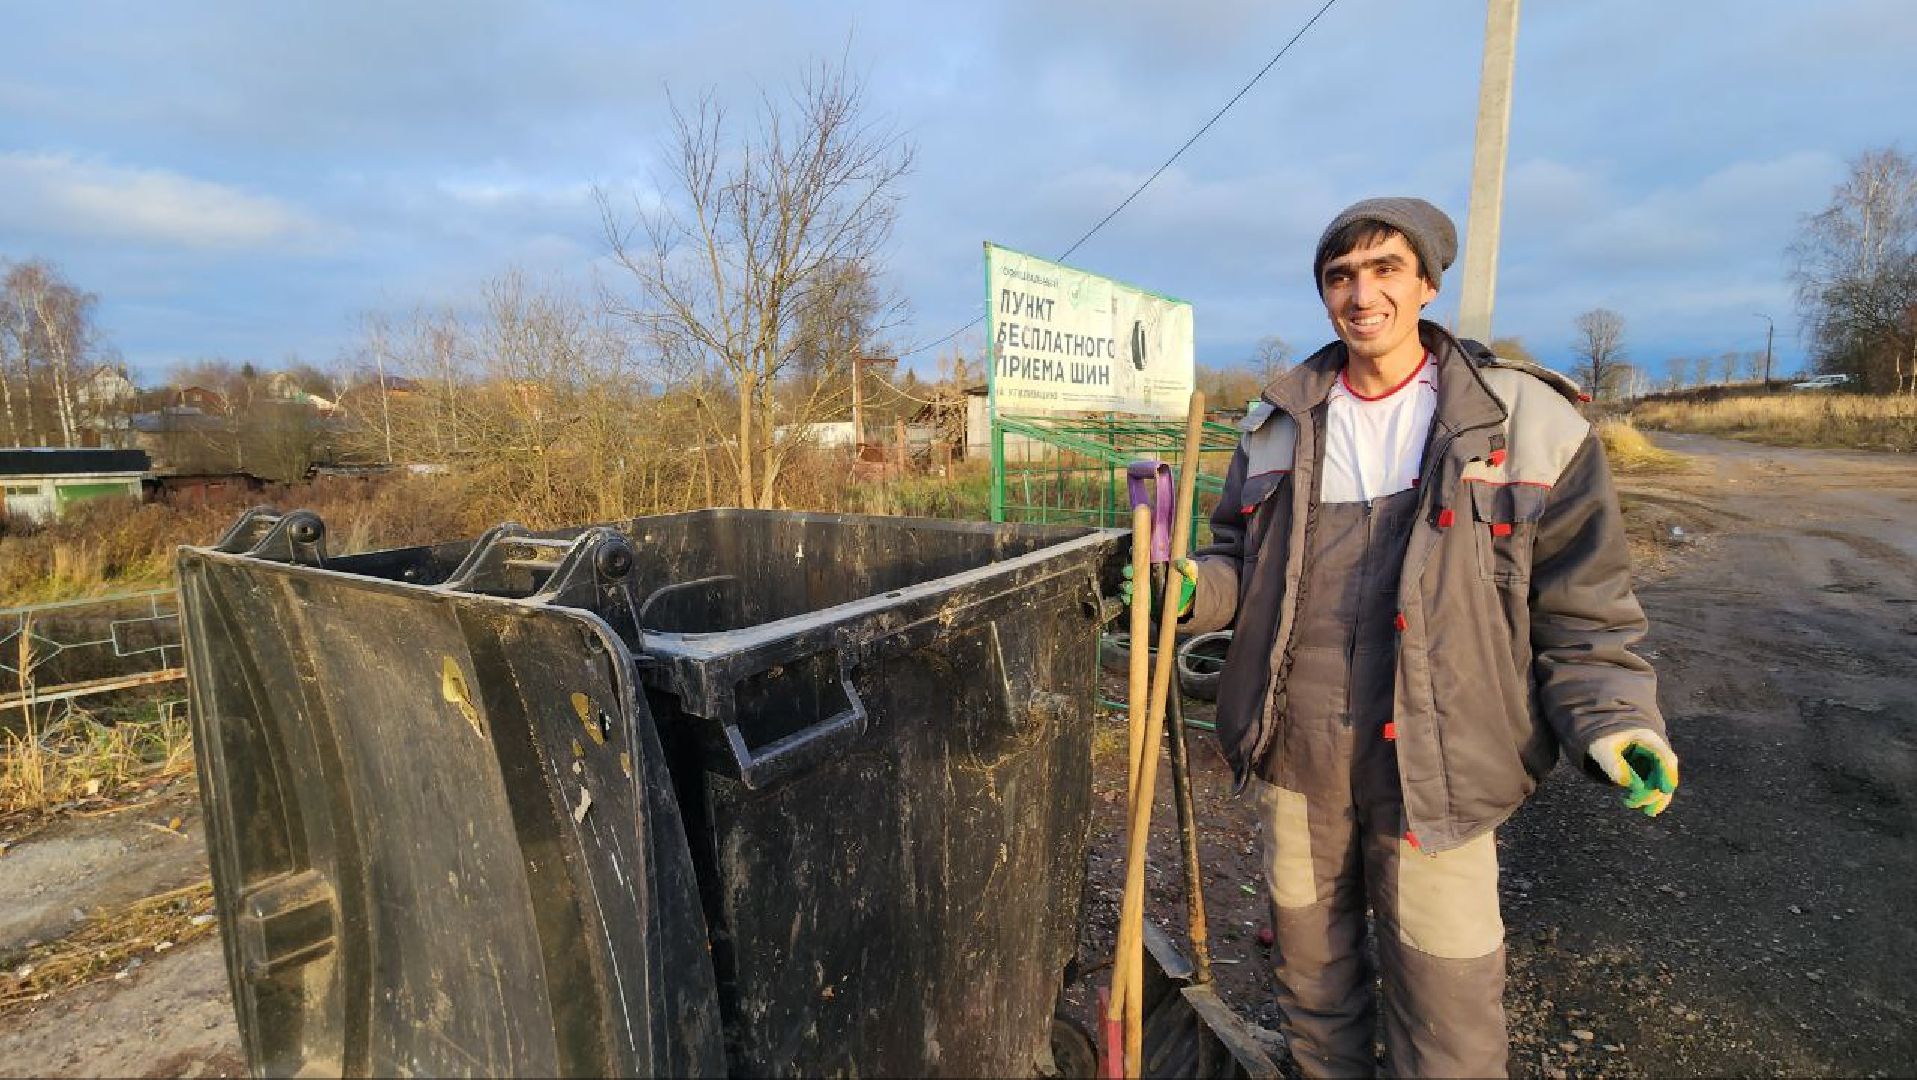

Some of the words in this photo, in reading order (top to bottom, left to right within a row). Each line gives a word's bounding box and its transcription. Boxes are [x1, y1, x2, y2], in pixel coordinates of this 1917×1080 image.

[1001, 289, 1054, 322] ПУНКТ
[997, 322, 1114, 359] БЕСПЛАТНОГО
[994, 355, 1064, 382] ПРИЕМА
[1071, 362, 1109, 385] ШИН
